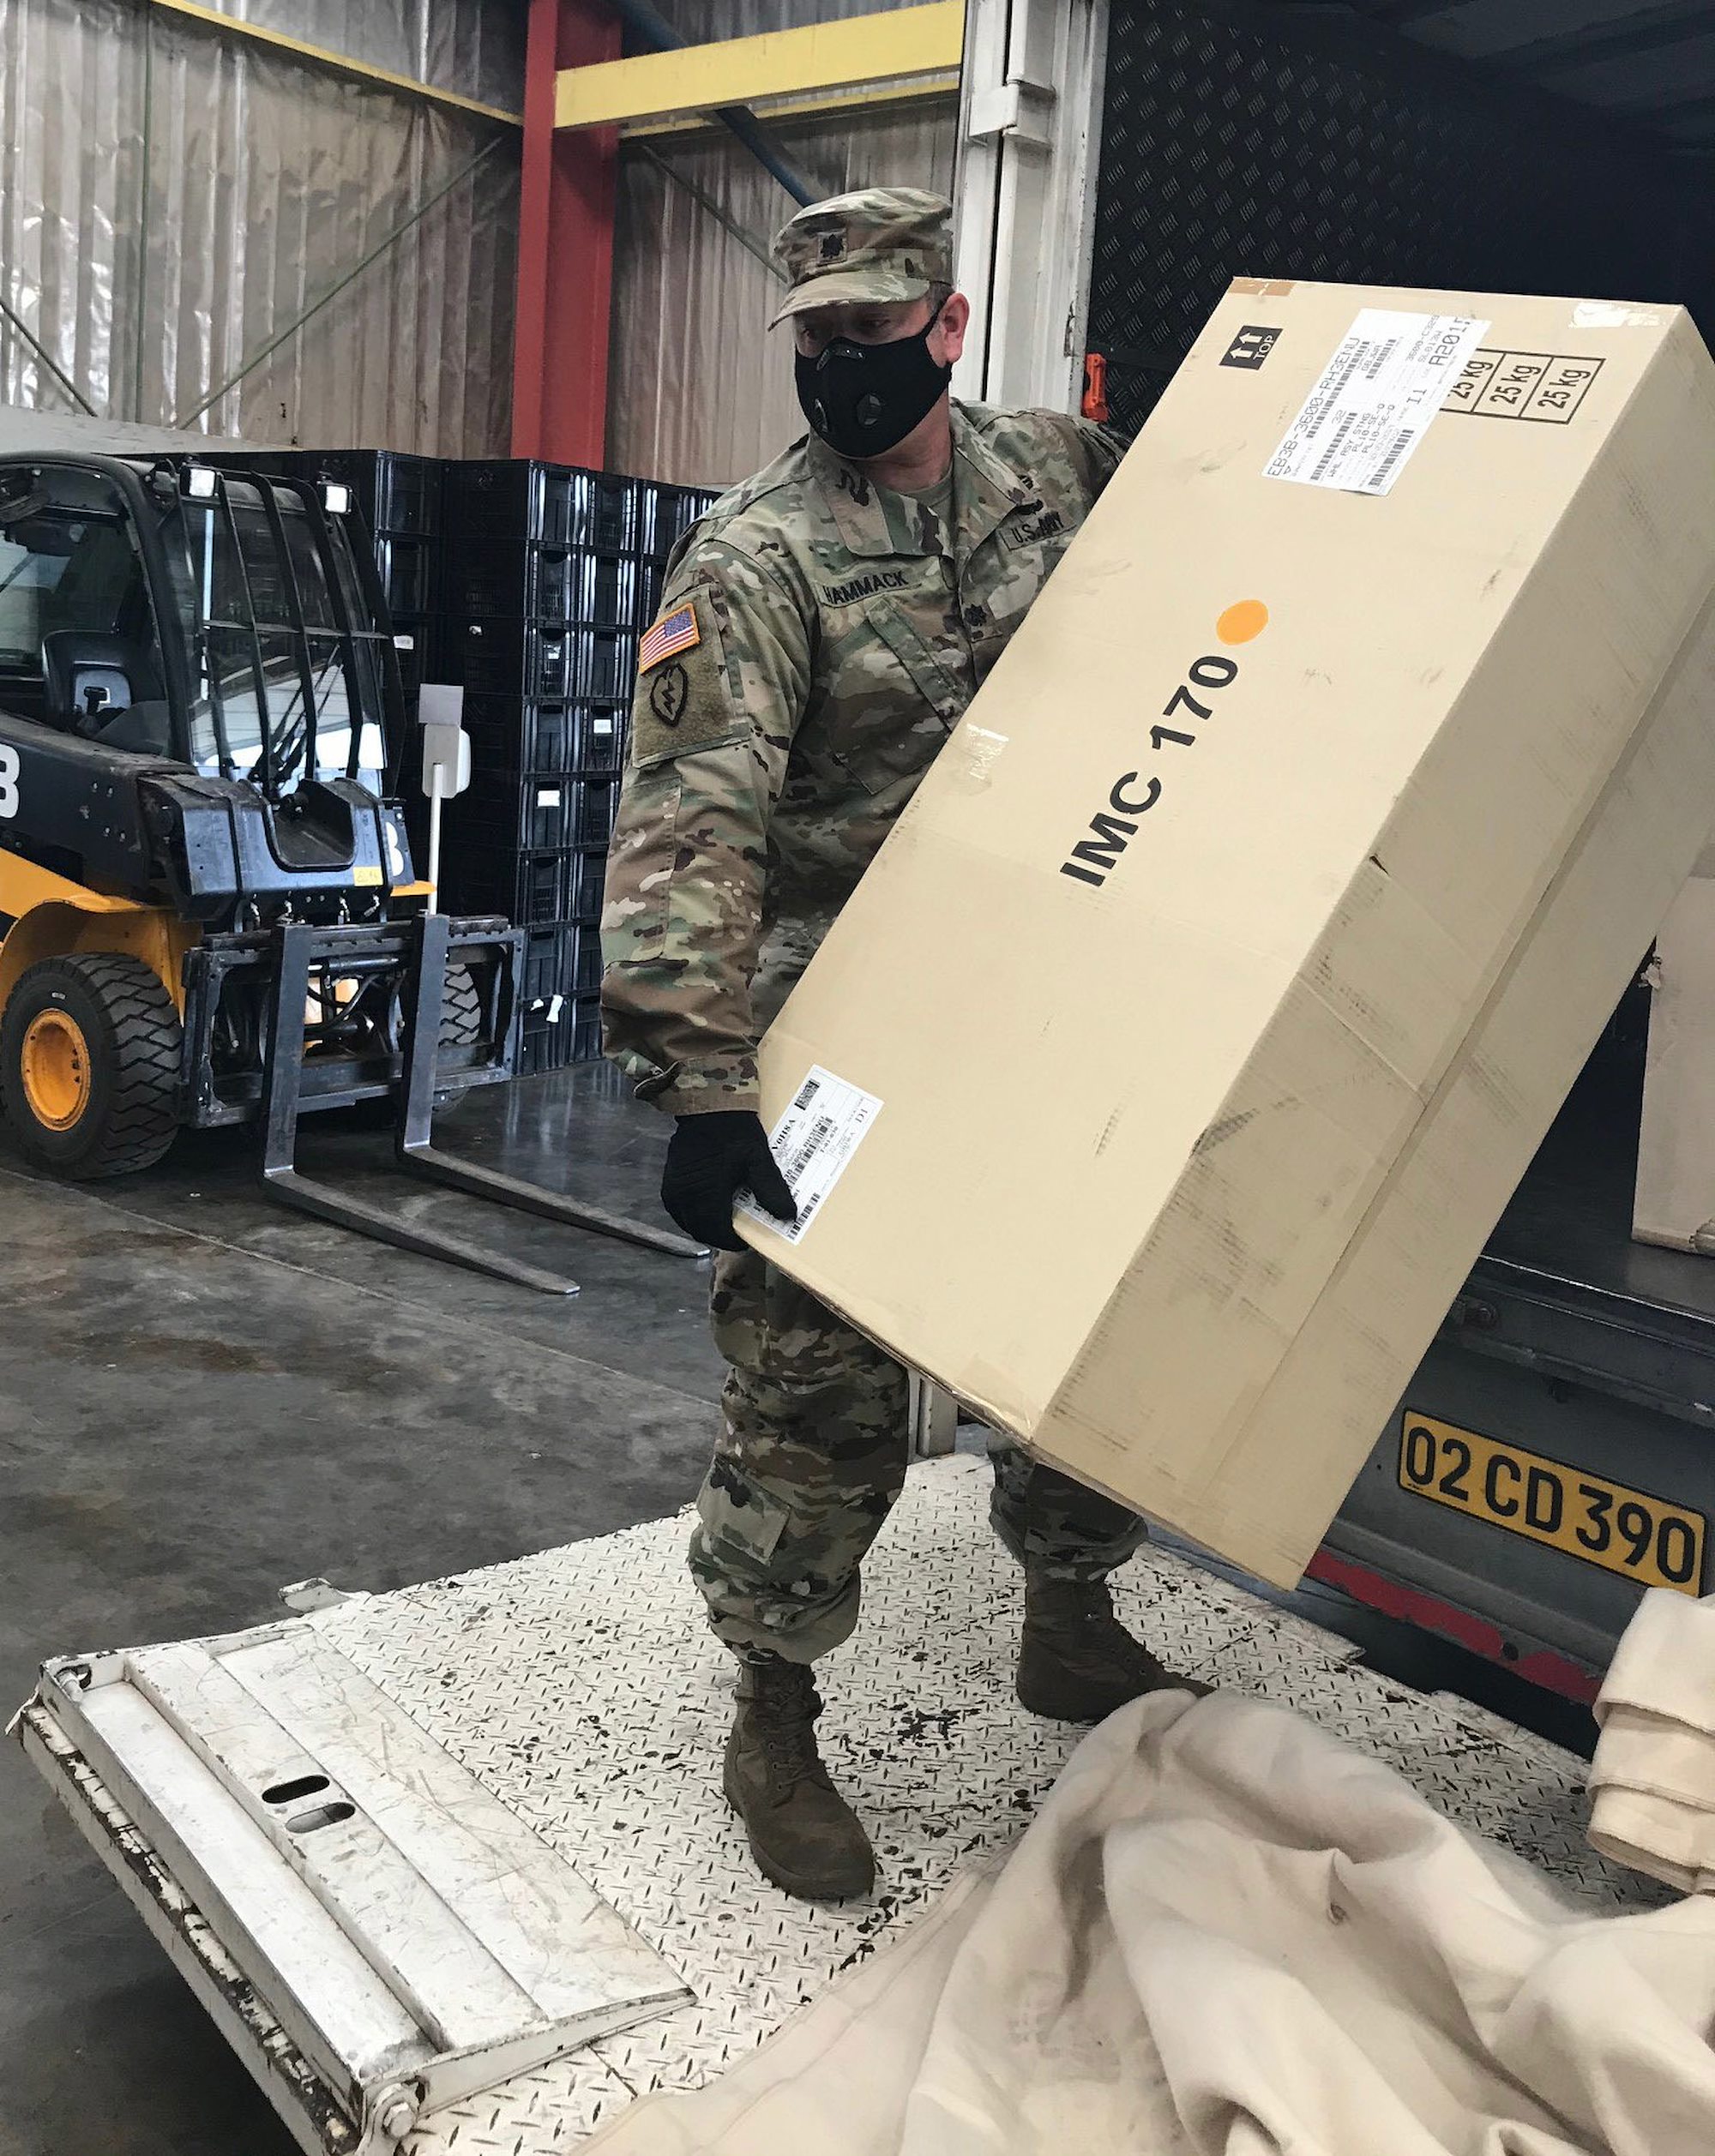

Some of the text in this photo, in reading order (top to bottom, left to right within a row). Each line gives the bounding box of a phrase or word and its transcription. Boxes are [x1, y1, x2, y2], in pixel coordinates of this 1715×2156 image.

[1253, 335, 1274, 360] TOP
[1489, 365, 1542, 405] 25 kg
[1537, 369, 1592, 409] 25 kg
[1060, 656, 1238, 886] IMC 170
[1406, 1426, 1695, 1583] 02 CD 390
